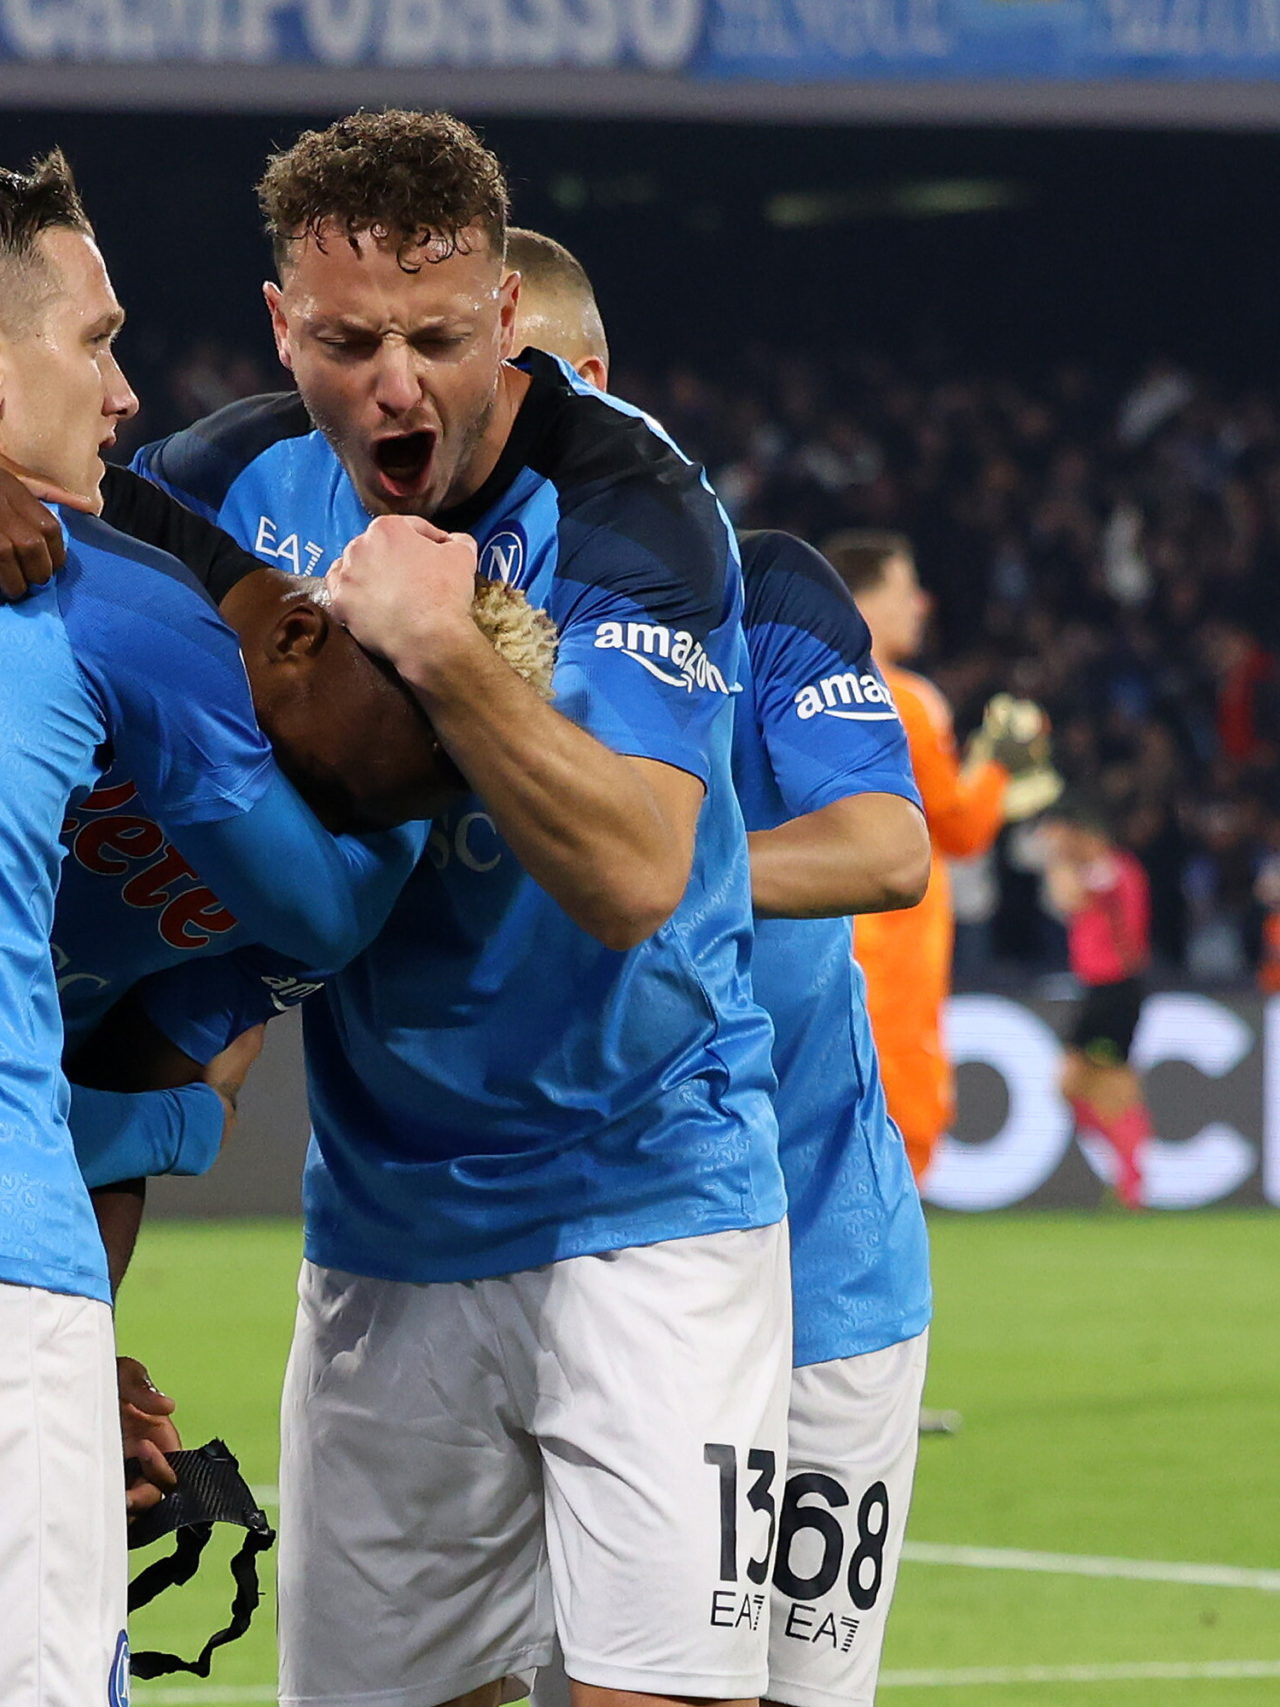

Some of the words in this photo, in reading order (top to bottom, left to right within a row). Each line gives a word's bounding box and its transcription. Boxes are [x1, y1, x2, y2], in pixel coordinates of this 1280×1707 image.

[593, 620, 731, 696] amazon
[56, 779, 240, 951] ete
[920, 990, 1280, 1212] OC
[703, 1442, 776, 1586] 13
[771, 1471, 889, 1611] 68
